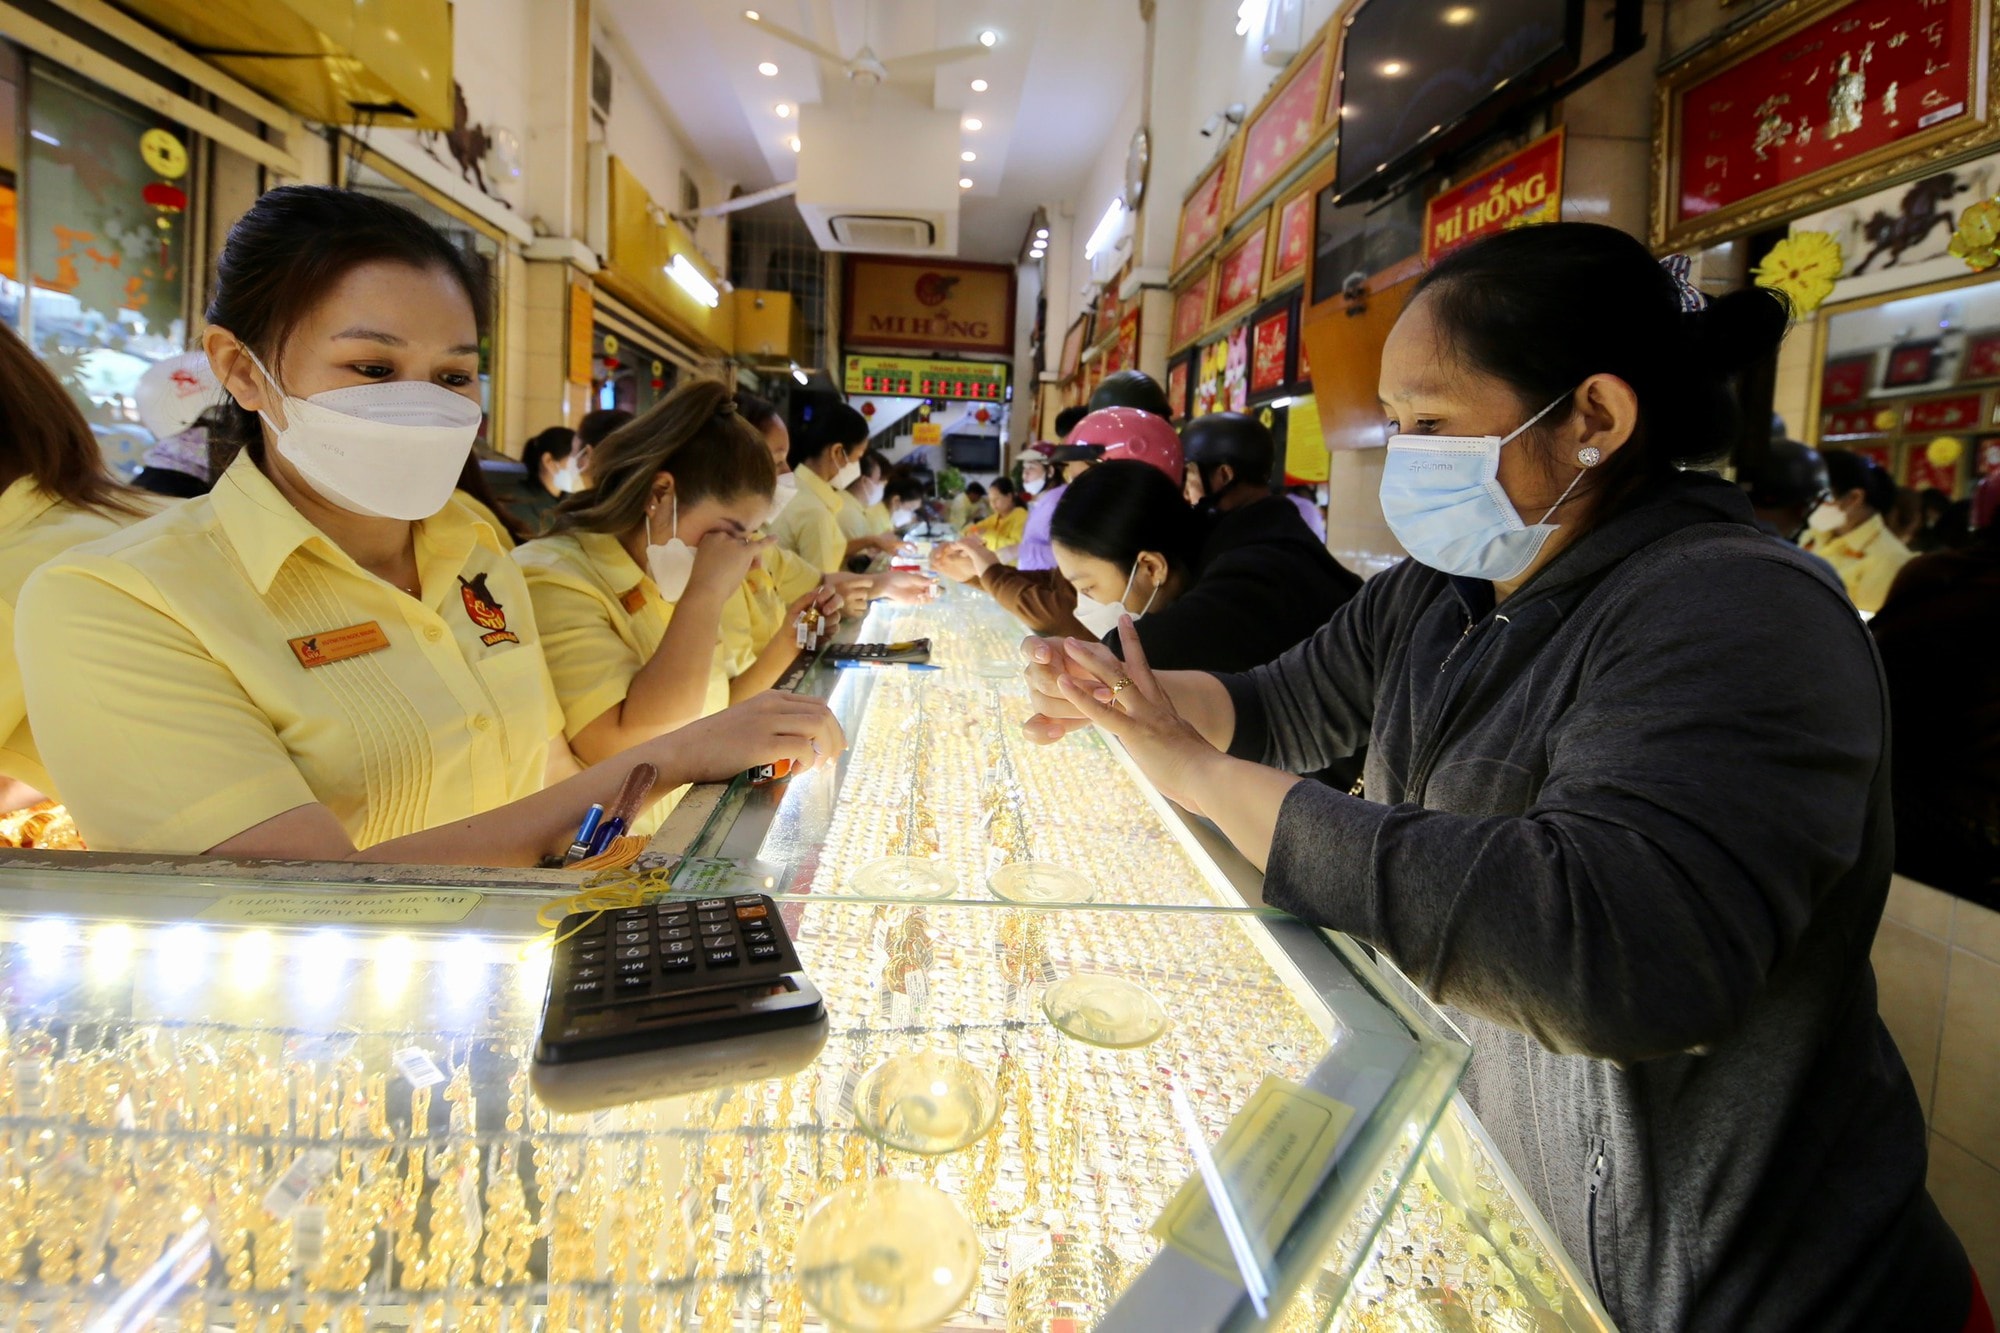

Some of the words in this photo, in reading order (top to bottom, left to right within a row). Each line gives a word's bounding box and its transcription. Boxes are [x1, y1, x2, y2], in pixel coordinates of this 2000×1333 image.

[869, 315, 906, 332] MI
[321, 442, 345, 457] KF94
[1422, 461, 1453, 471] Gunma
[626, 920, 638, 929] 3
[667, 916, 679, 924] 2
[709, 924, 722, 933] 4
[626, 933, 639, 942] 6
[714, 937, 724, 946] 7
[670, 942, 682, 951] 8
[754, 946, 774, 954] MC
[626, 947, 639, 956] 9
[712, 951, 732, 959] MR
[621, 962, 644, 970] M+
